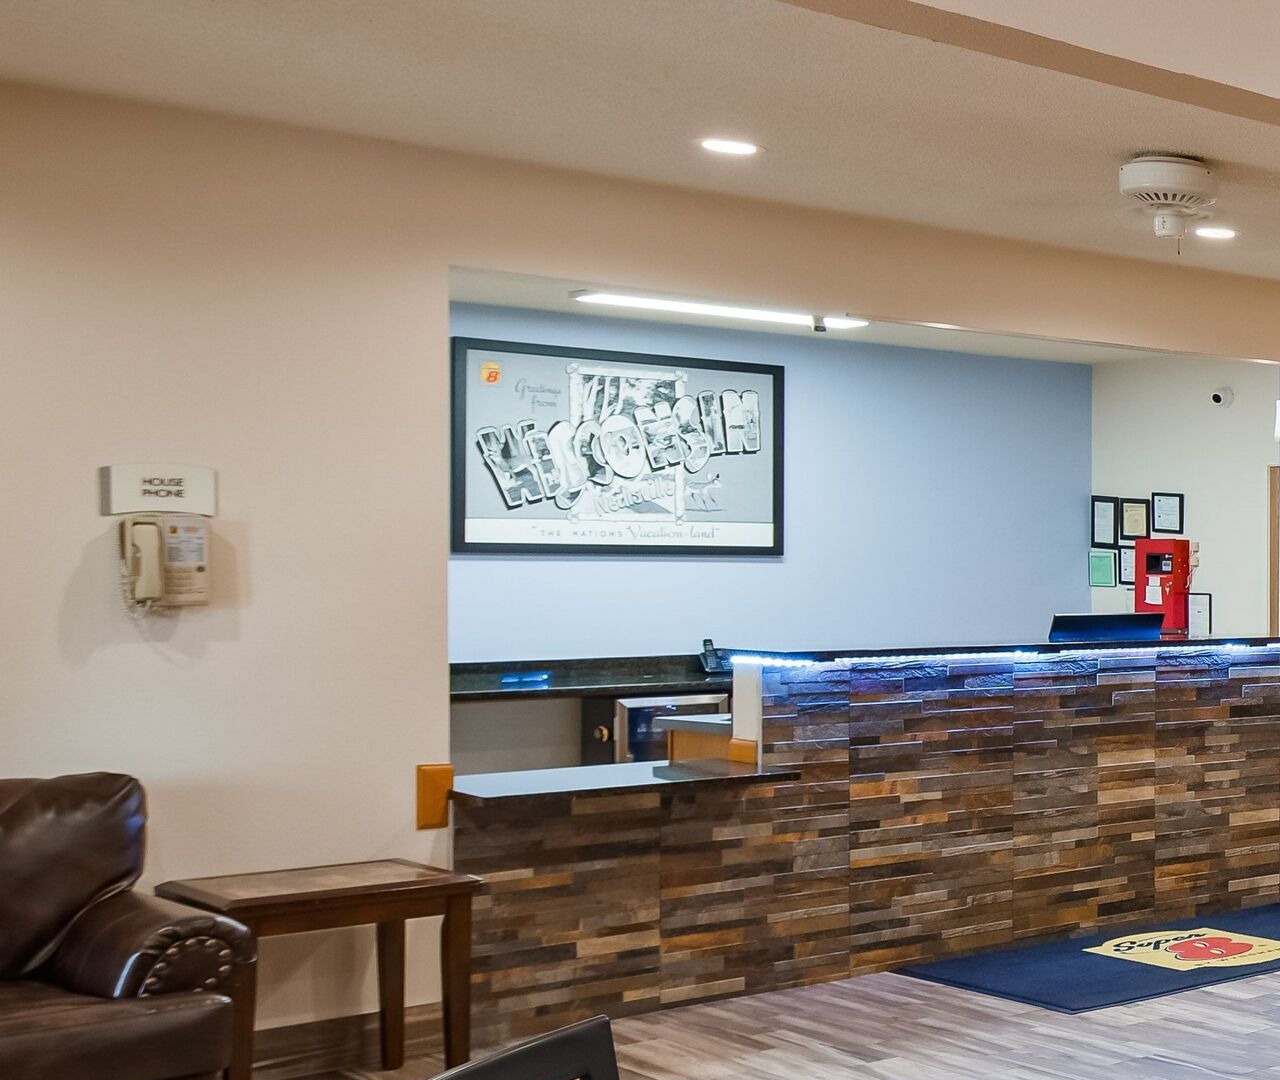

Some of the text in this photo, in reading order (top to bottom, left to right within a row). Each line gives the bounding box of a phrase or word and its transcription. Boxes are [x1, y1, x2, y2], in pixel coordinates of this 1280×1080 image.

[476, 389, 761, 513] WISCONSIN
[143, 478, 184, 486] HOUSE
[143, 489, 184, 497] PHONE
[1113, 932, 1207, 951] Super
[1165, 936, 1254, 961] 8
